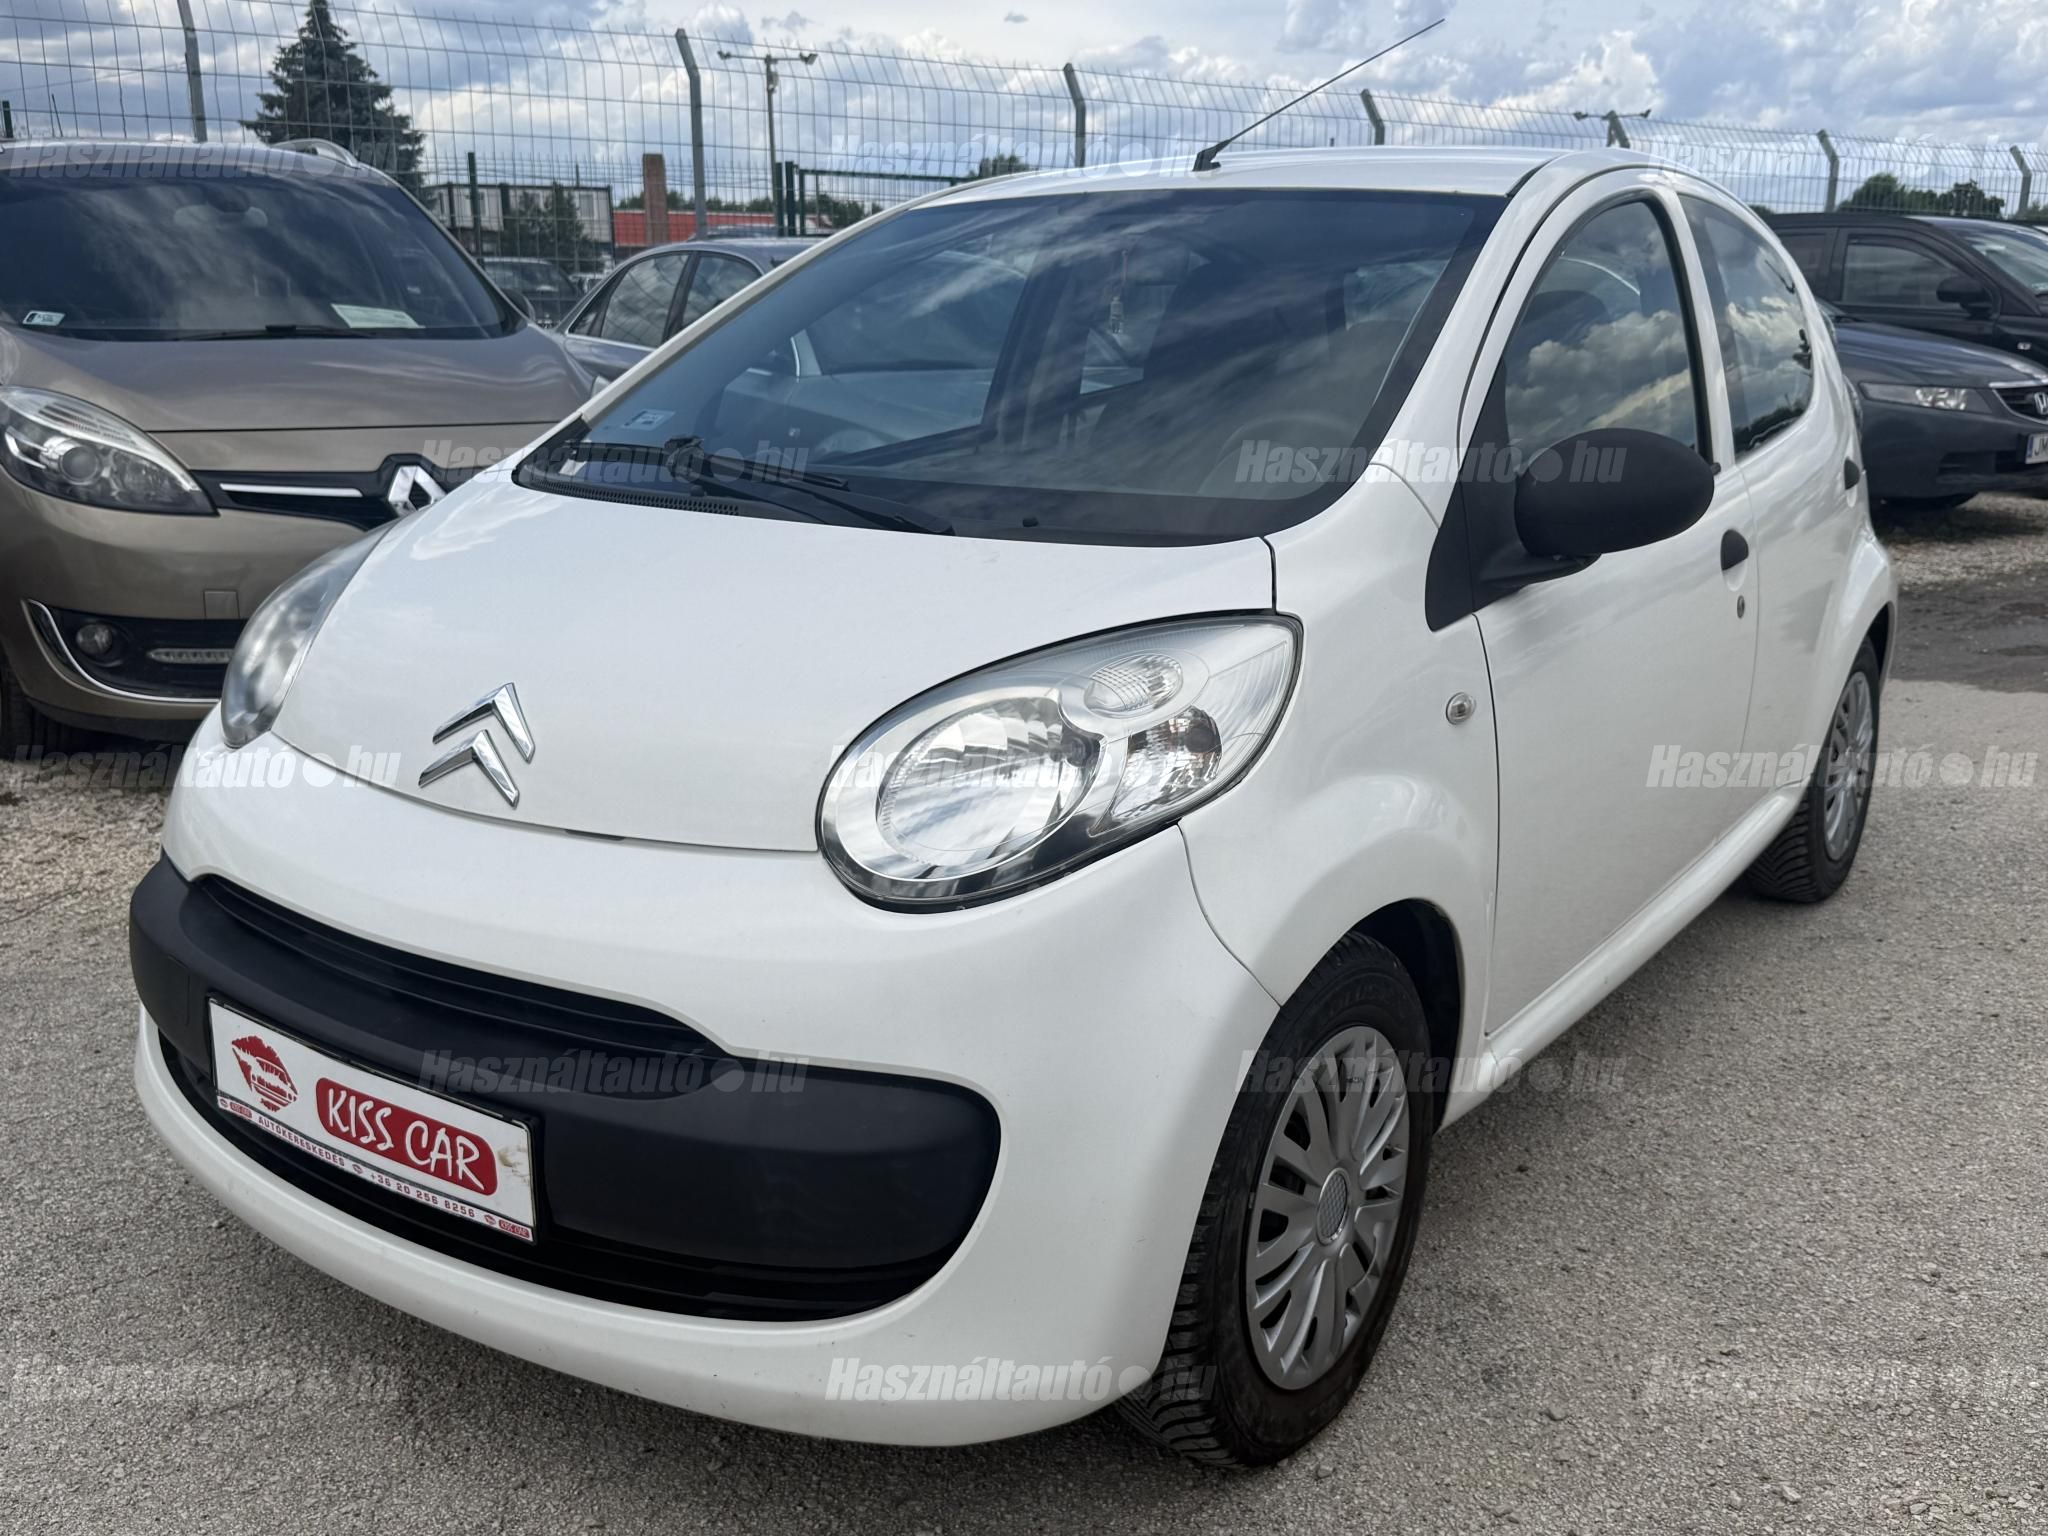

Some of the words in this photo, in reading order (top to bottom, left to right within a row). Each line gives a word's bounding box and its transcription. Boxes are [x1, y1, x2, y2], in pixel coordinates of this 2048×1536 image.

[328, 1087, 394, 1151] KISS
[405, 1120, 485, 1191] CAR
[370, 1173, 391, 1187] +36
[396, 1183, 411, 1195] 20
[416, 1190, 438, 1205] 256
[444, 1201, 476, 1218] 8256
